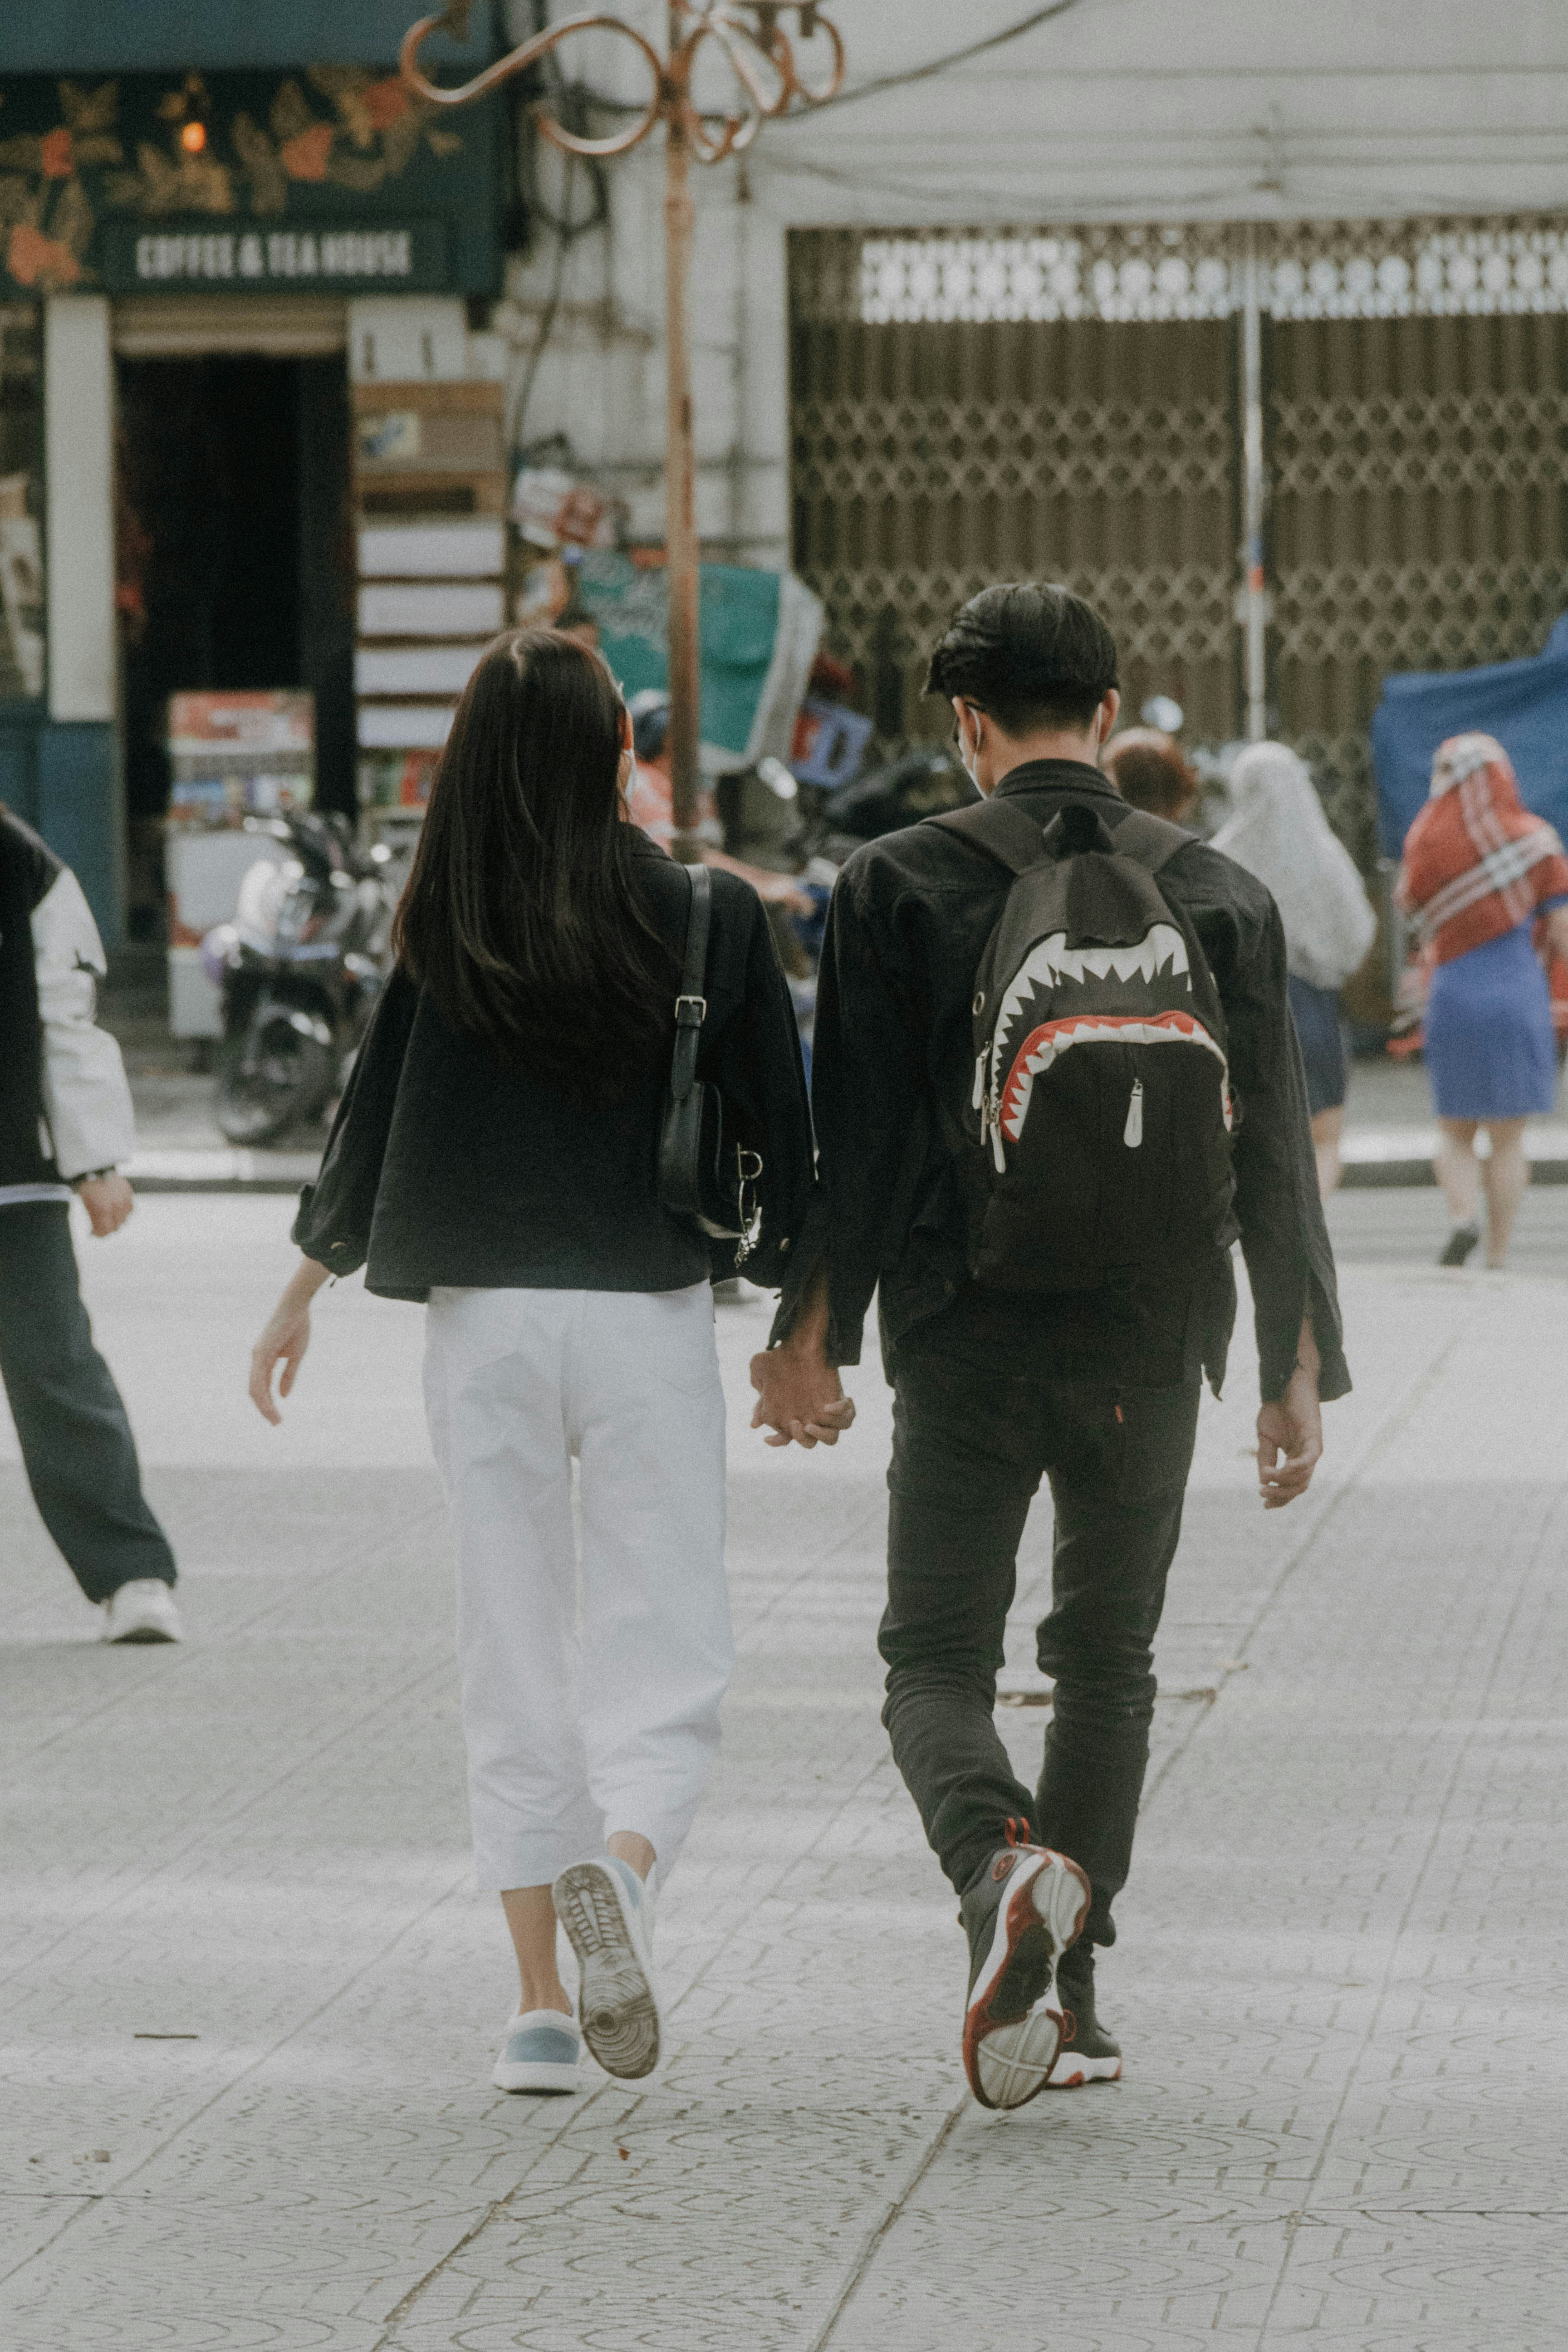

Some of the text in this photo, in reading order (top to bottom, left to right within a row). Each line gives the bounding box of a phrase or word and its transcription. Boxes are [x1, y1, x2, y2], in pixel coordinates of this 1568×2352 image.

[137, 231, 409, 278] COFFEE & TEA HOUSE
